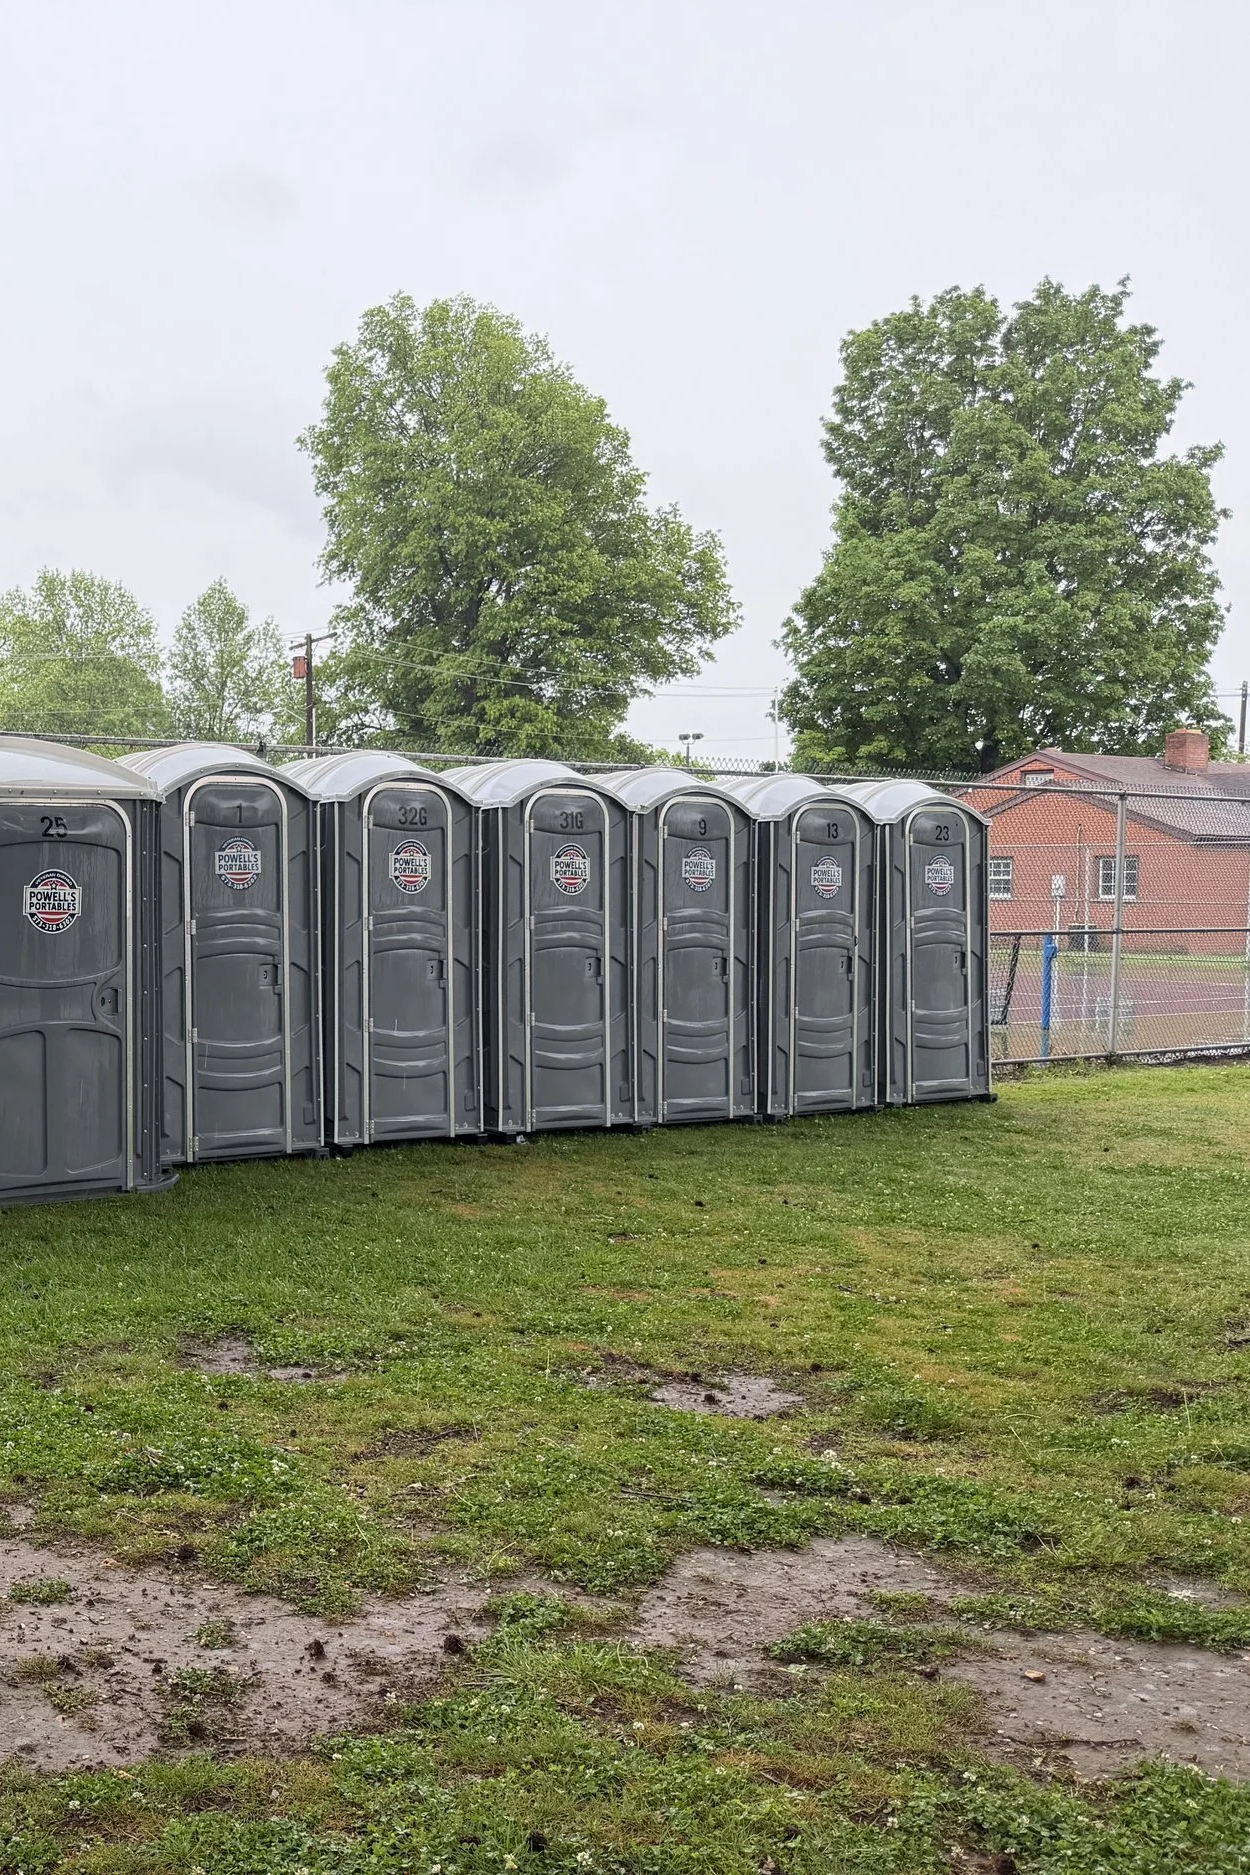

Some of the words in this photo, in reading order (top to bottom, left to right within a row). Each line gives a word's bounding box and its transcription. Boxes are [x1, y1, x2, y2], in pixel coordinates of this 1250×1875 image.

[236, 802, 243, 824] 1
[398, 806, 428, 826] 32G
[559, 811, 584, 829] 31G
[40, 816, 68, 838] 25
[698, 819, 707, 836] 9
[827, 822, 839, 839] 13
[935, 825, 950, 841] 23
[218, 853, 259, 864] POWELL'S
[393, 857, 428, 867] POWELL'S
[218, 863, 259, 872] PORTABLES
[393, 866, 428, 875] PORTABLES
[554, 860, 587, 870] POWELL'S
[554, 869, 587, 877] PORTABLES
[29, 891, 77, 902] POWELL'S
[29, 901, 77, 912] PORTABLES
